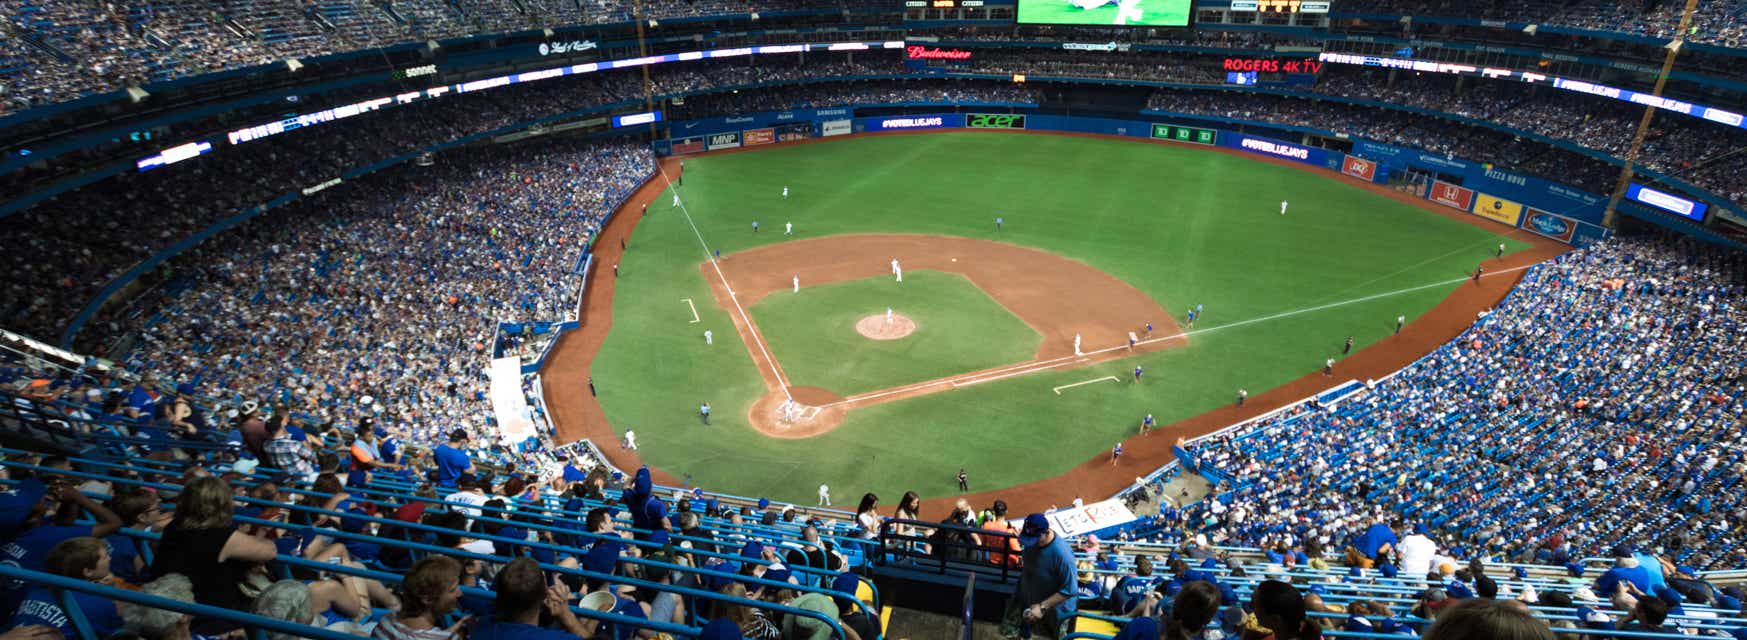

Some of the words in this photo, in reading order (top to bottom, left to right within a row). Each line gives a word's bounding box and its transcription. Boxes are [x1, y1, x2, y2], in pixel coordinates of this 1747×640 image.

[907, 46, 972, 59] Budweiser
[406, 64, 437, 77] sonnet
[1223, 59, 1279, 72] ROGERS
[1282, 61, 1301, 72] 4K
[1303, 61, 1322, 74] TV
[971, 115, 1021, 128] acer
[713, 134, 736, 145] MNP
[1157, 128, 1168, 136] TD
[1179, 130, 1189, 138] TD
[1241, 138, 1309, 160] #VOTEBLUEJAYS
[1485, 169, 1506, 181] PIZZA
[1507, 173, 1526, 186] NOVA
